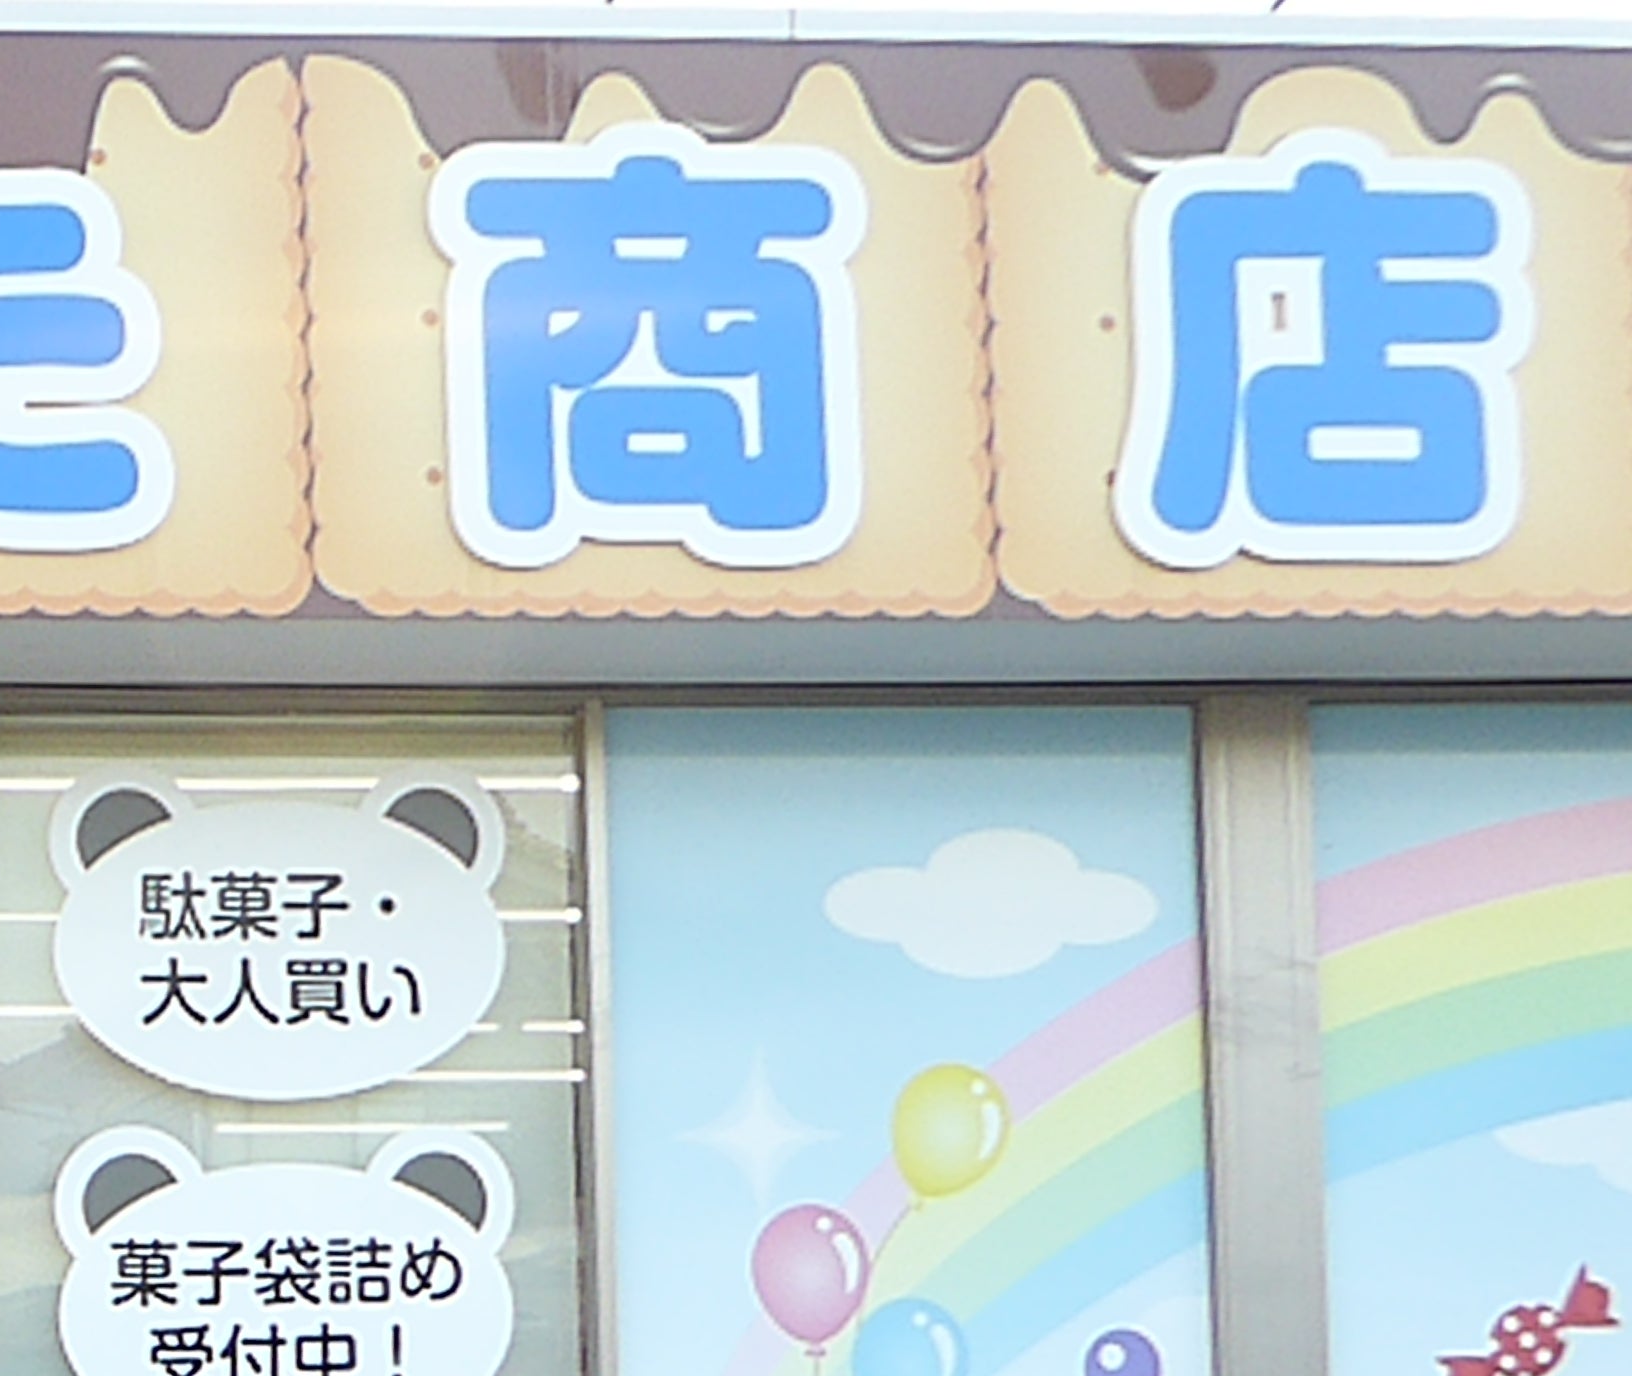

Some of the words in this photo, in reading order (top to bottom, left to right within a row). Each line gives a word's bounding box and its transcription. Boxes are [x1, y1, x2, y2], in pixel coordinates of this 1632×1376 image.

[141, 958, 422, 1025] 大人買い
[111, 1237, 463, 1306] 菓子袋詰め
